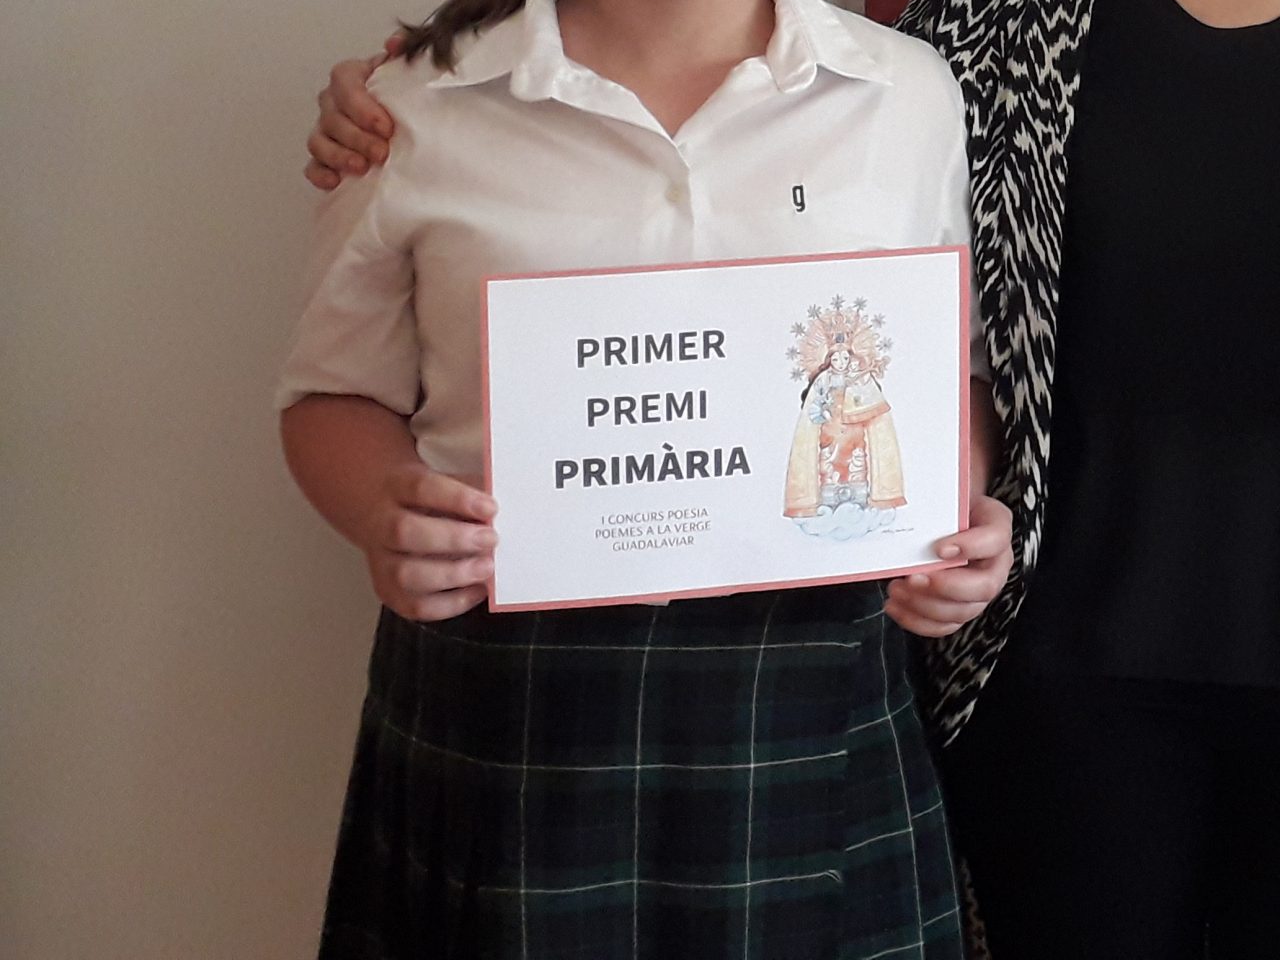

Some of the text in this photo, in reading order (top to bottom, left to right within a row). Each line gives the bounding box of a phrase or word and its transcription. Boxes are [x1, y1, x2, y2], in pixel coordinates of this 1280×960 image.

[791, 184, 806, 212] g
[576, 329, 726, 368] PRIMER
[587, 390, 707, 427] PREMI
[555, 442, 751, 489] PRIMÀRIA
[595, 520, 711, 539] POEMES A LA VERGE
[608, 510, 665, 525] CONCURS
[667, 508, 709, 520] POESIA
[612, 535, 695, 552] GUADALAVIAR
